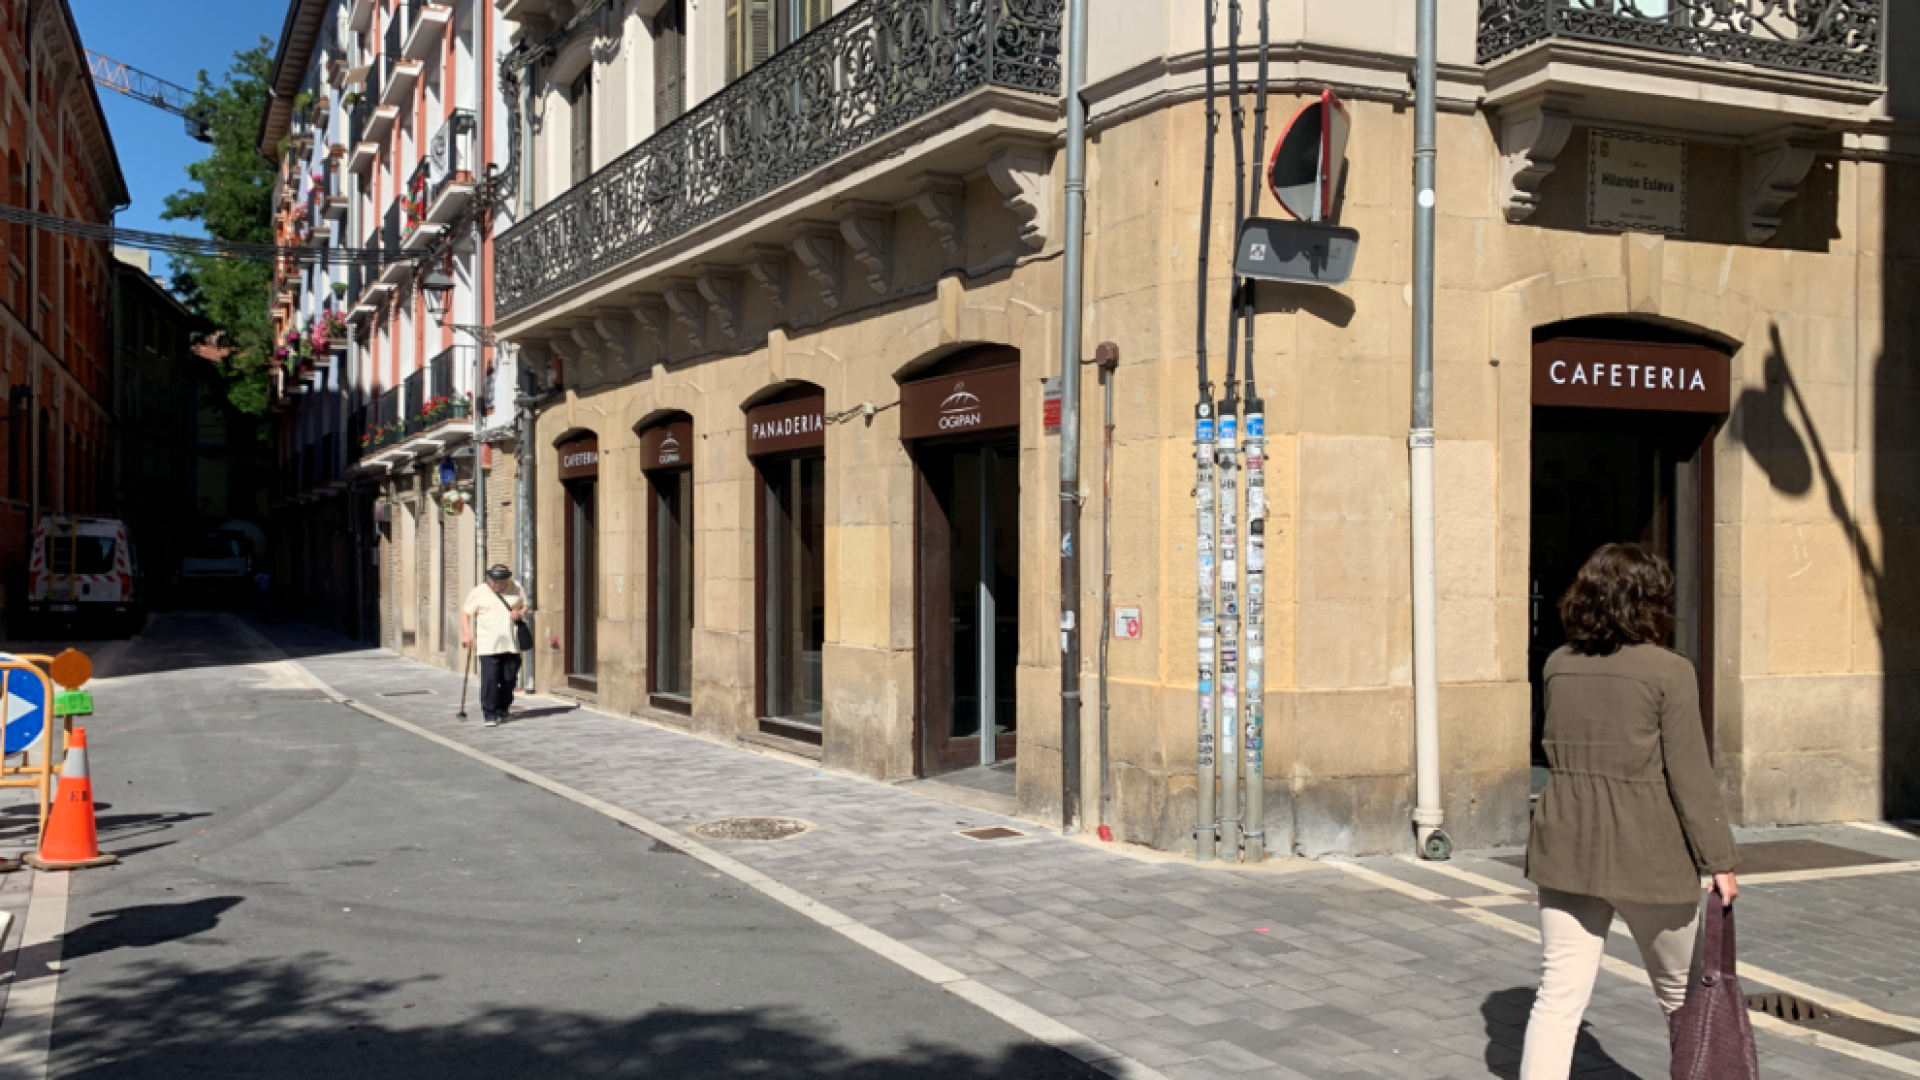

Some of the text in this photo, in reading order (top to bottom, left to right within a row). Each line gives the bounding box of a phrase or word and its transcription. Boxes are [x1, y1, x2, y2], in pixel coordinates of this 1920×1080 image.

[1642, 176, 1674, 192] Eslava
[1550, 360, 1706, 391] CAFETERIA
[752, 413, 823, 440] PANADERIA
[938, 412, 981, 429] OGIPAN
[564, 451, 598, 468] CAFETERIA
